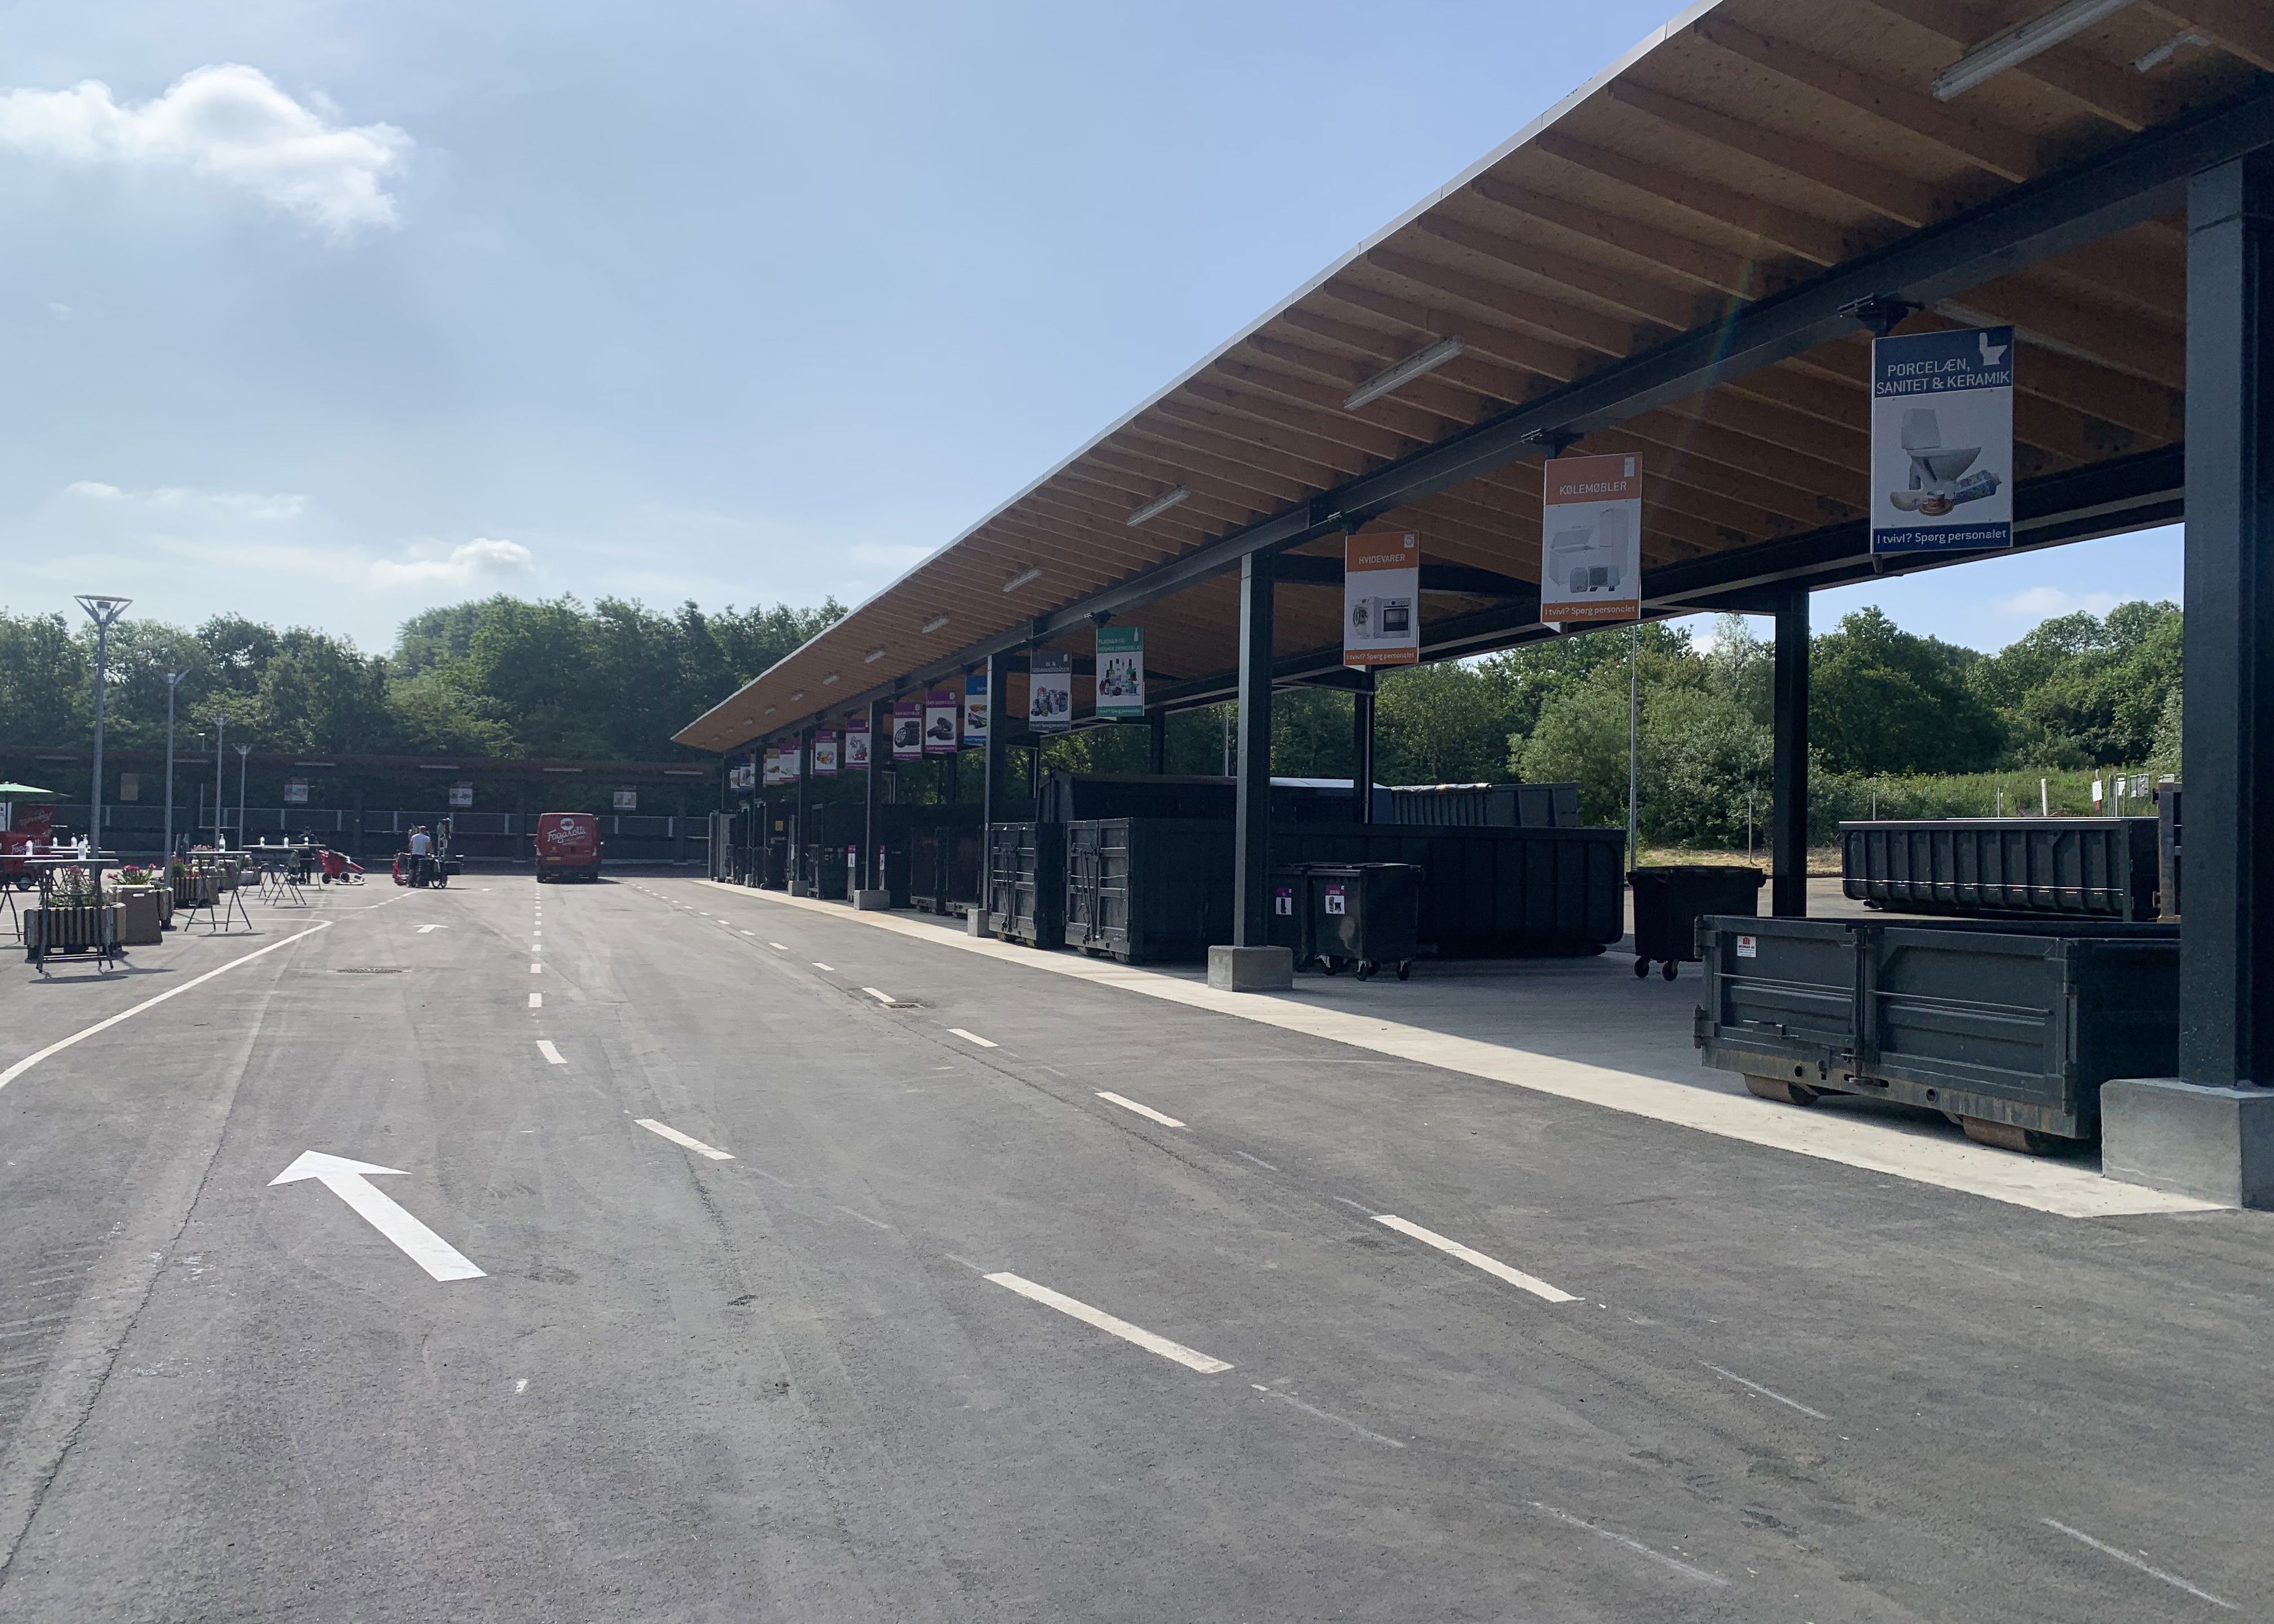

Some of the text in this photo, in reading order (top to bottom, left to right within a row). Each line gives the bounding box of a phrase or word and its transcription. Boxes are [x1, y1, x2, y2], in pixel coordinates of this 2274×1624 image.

[1888, 358, 1971, 377] PORCELÆN,
[1877, 370, 2009, 394] SANITET & KERAMIK
[1559, 481, 1627, 496] KØLEMØBLER
[1883, 533, 1912, 544] tvivl?
[1915, 532, 1946, 545] Spørg
[1948, 528, 2007, 544] personalet
[1359, 554, 1405, 564] HVIDEVARER
[1549, 607, 1570, 616] tvivl?
[1571, 607, 1593, 616] Spørg
[1594, 605, 1635, 615] personalet
